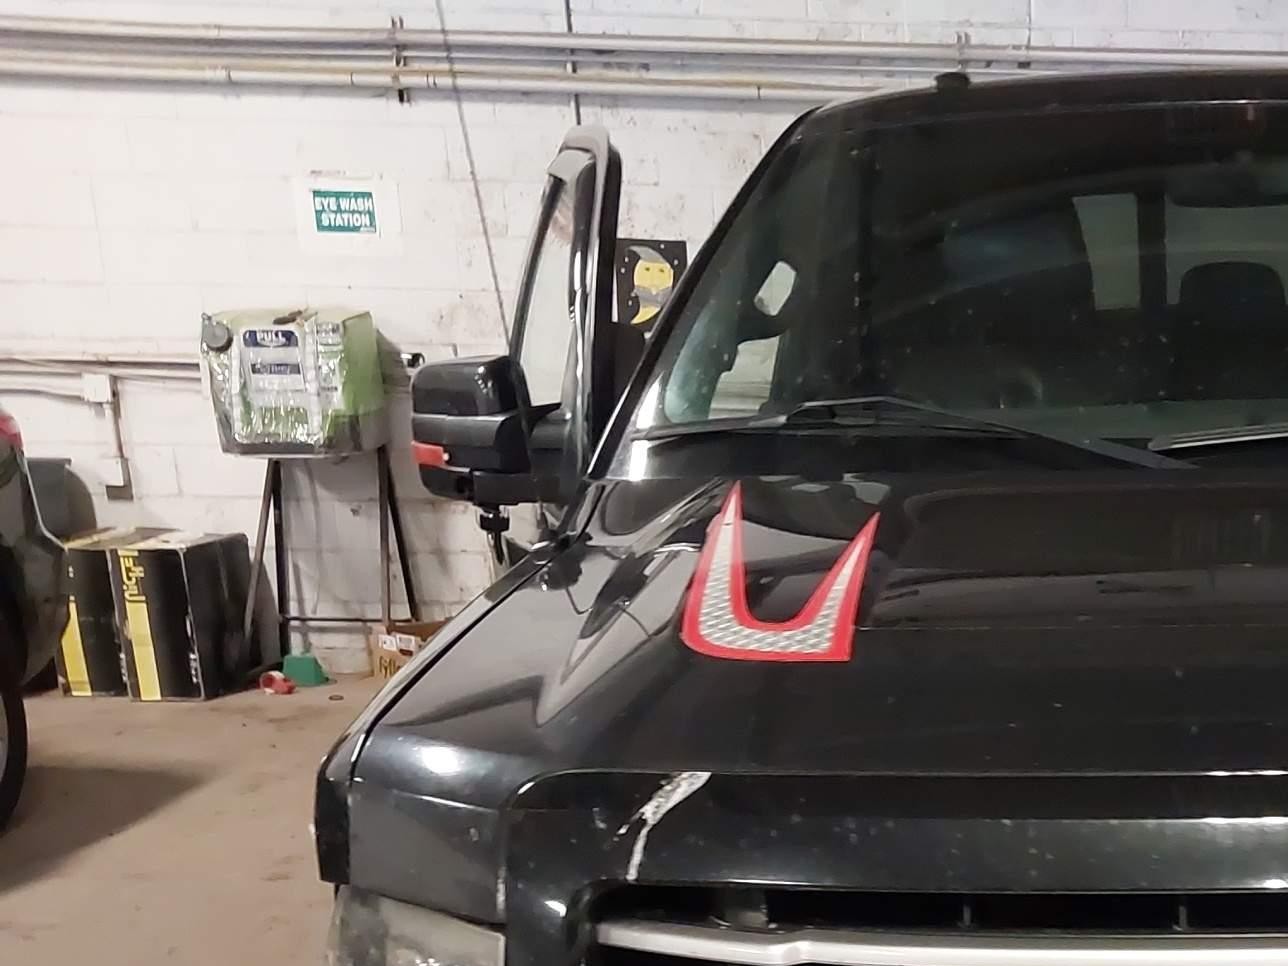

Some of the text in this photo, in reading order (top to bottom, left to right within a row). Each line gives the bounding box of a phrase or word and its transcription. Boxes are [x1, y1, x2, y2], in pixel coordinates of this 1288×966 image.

[314, 196, 373, 211] EYE WASH
[321, 212, 370, 227] STATION
